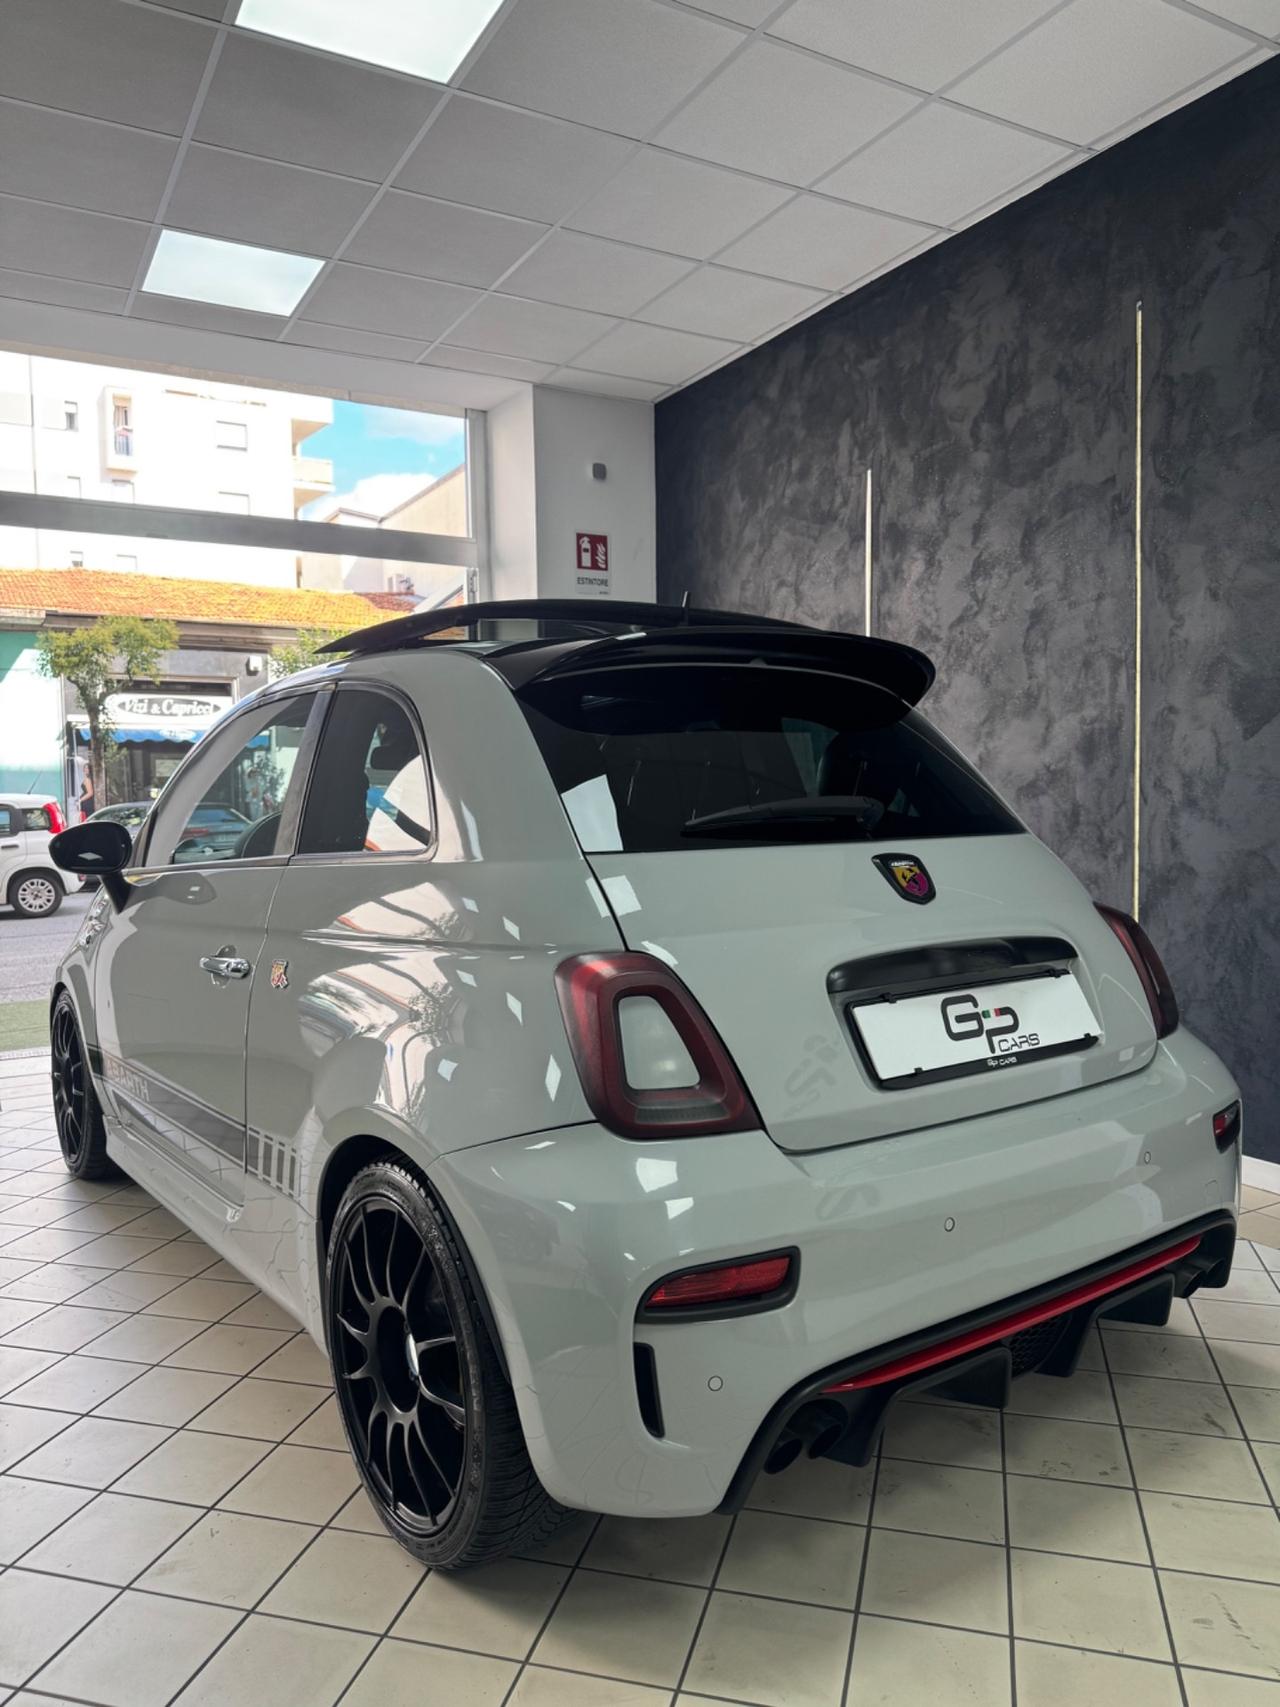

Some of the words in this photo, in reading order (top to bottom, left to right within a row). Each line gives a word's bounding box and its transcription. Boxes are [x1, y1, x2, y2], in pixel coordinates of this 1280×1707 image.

[577, 577, 608, 587] ESTINTORE
[151, 703, 161, 714] &
[998, 1033, 1041, 1052] CARS
